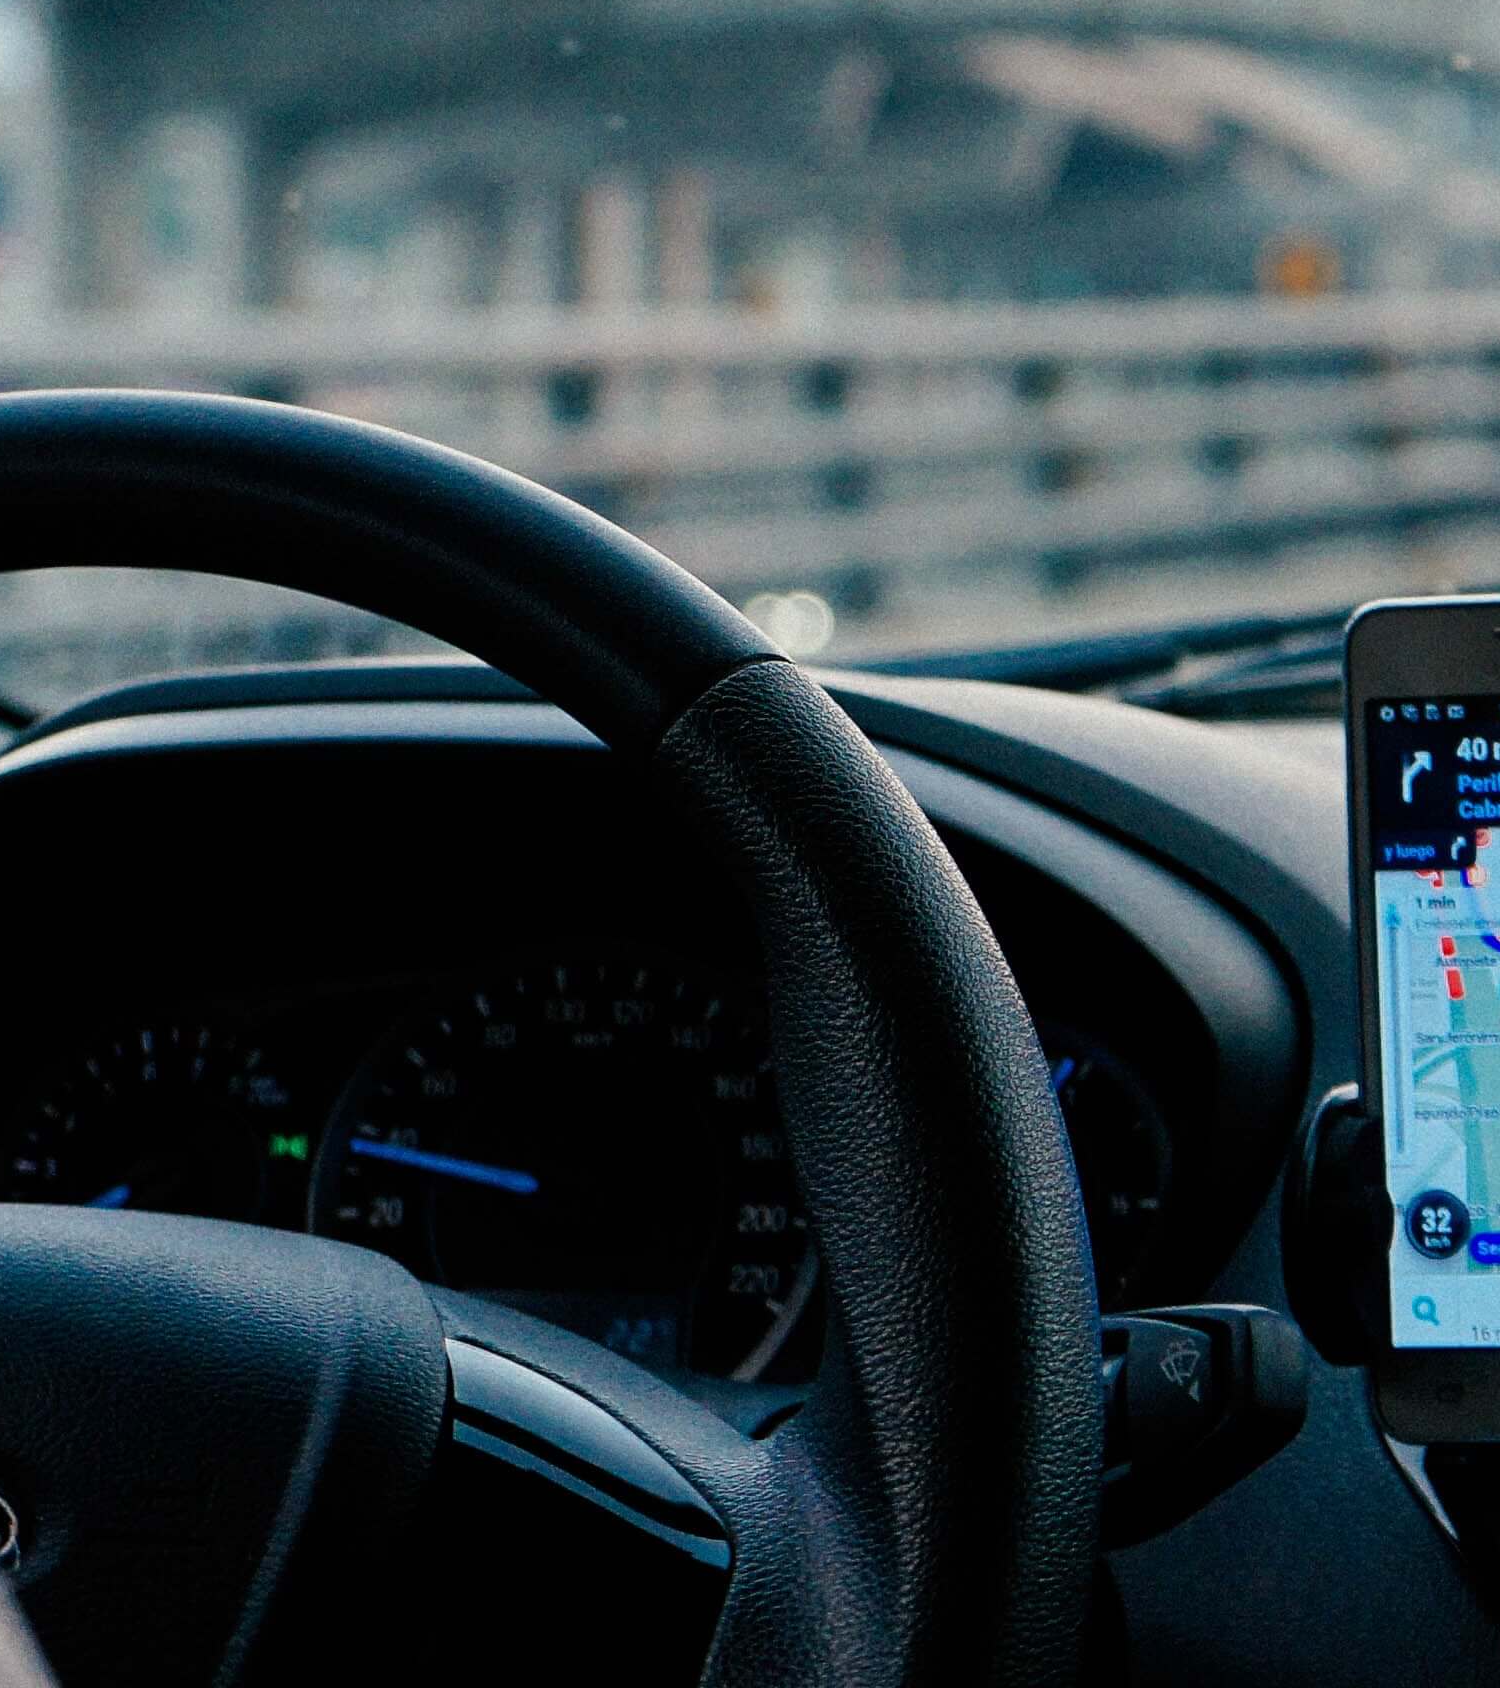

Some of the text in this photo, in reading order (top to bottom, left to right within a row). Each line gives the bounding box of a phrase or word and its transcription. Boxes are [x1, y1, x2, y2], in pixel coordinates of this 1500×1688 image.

[1456, 737, 1487, 762] 40
[1384, 843, 1436, 862] y luego
[1428, 896, 1456, 909] min
[367, 1195, 404, 1228] 20
[738, 1202, 787, 1232] 200
[1421, 1206, 1453, 1234] 32
[1473, 1326, 1491, 1342] 16
